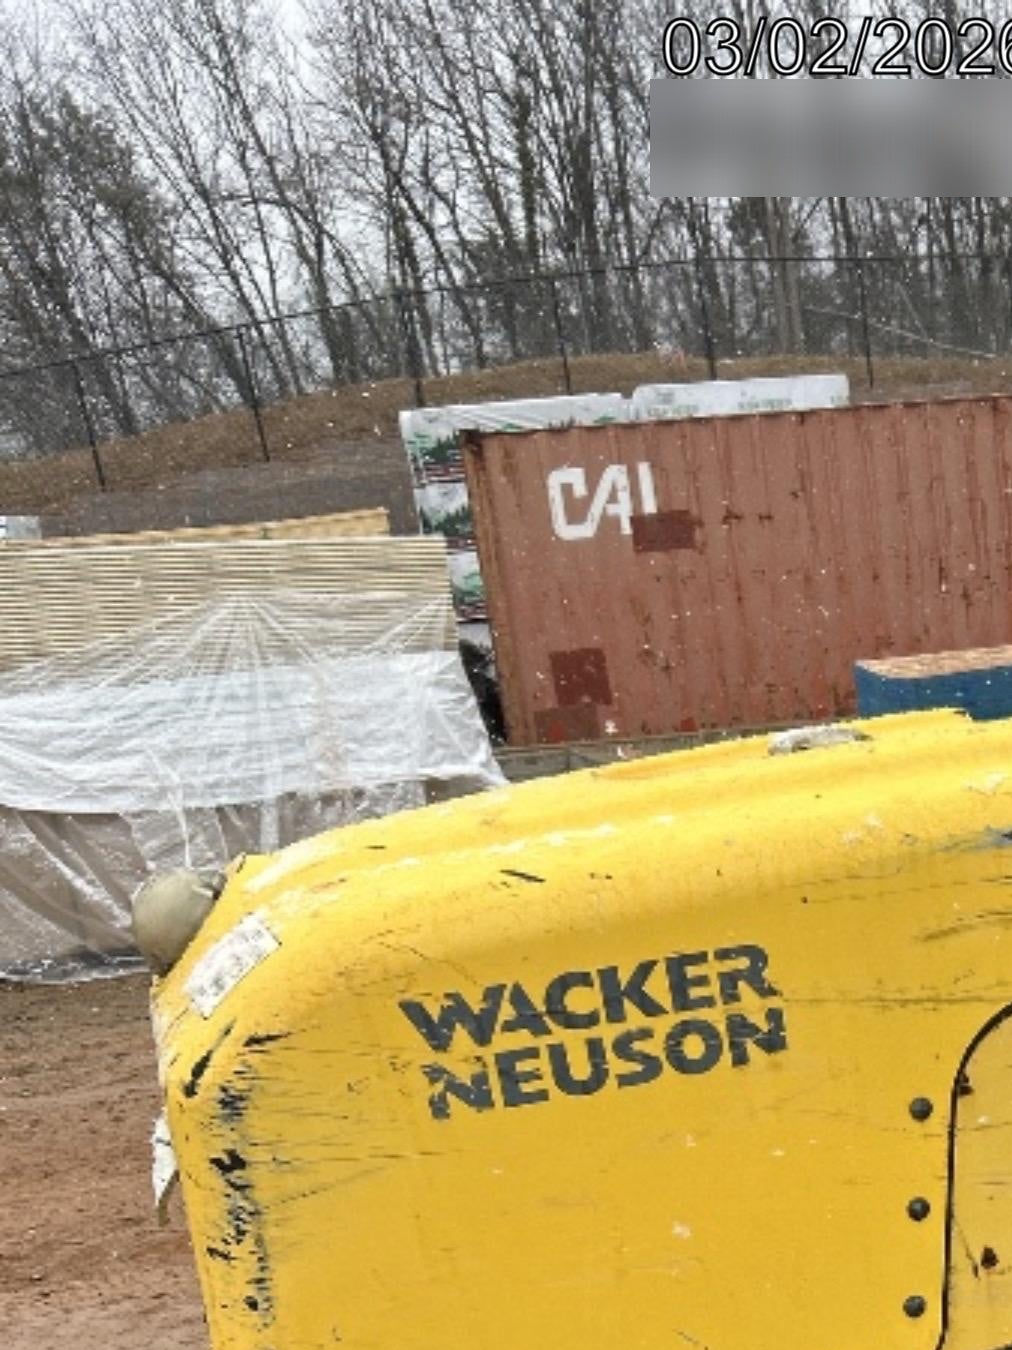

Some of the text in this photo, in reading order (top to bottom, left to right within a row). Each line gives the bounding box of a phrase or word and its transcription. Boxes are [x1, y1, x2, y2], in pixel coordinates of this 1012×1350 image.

[547, 461, 658, 541] CAI
[398, 944, 784, 1053] WACKER
[420, 1007, 788, 1121] NEUSON
